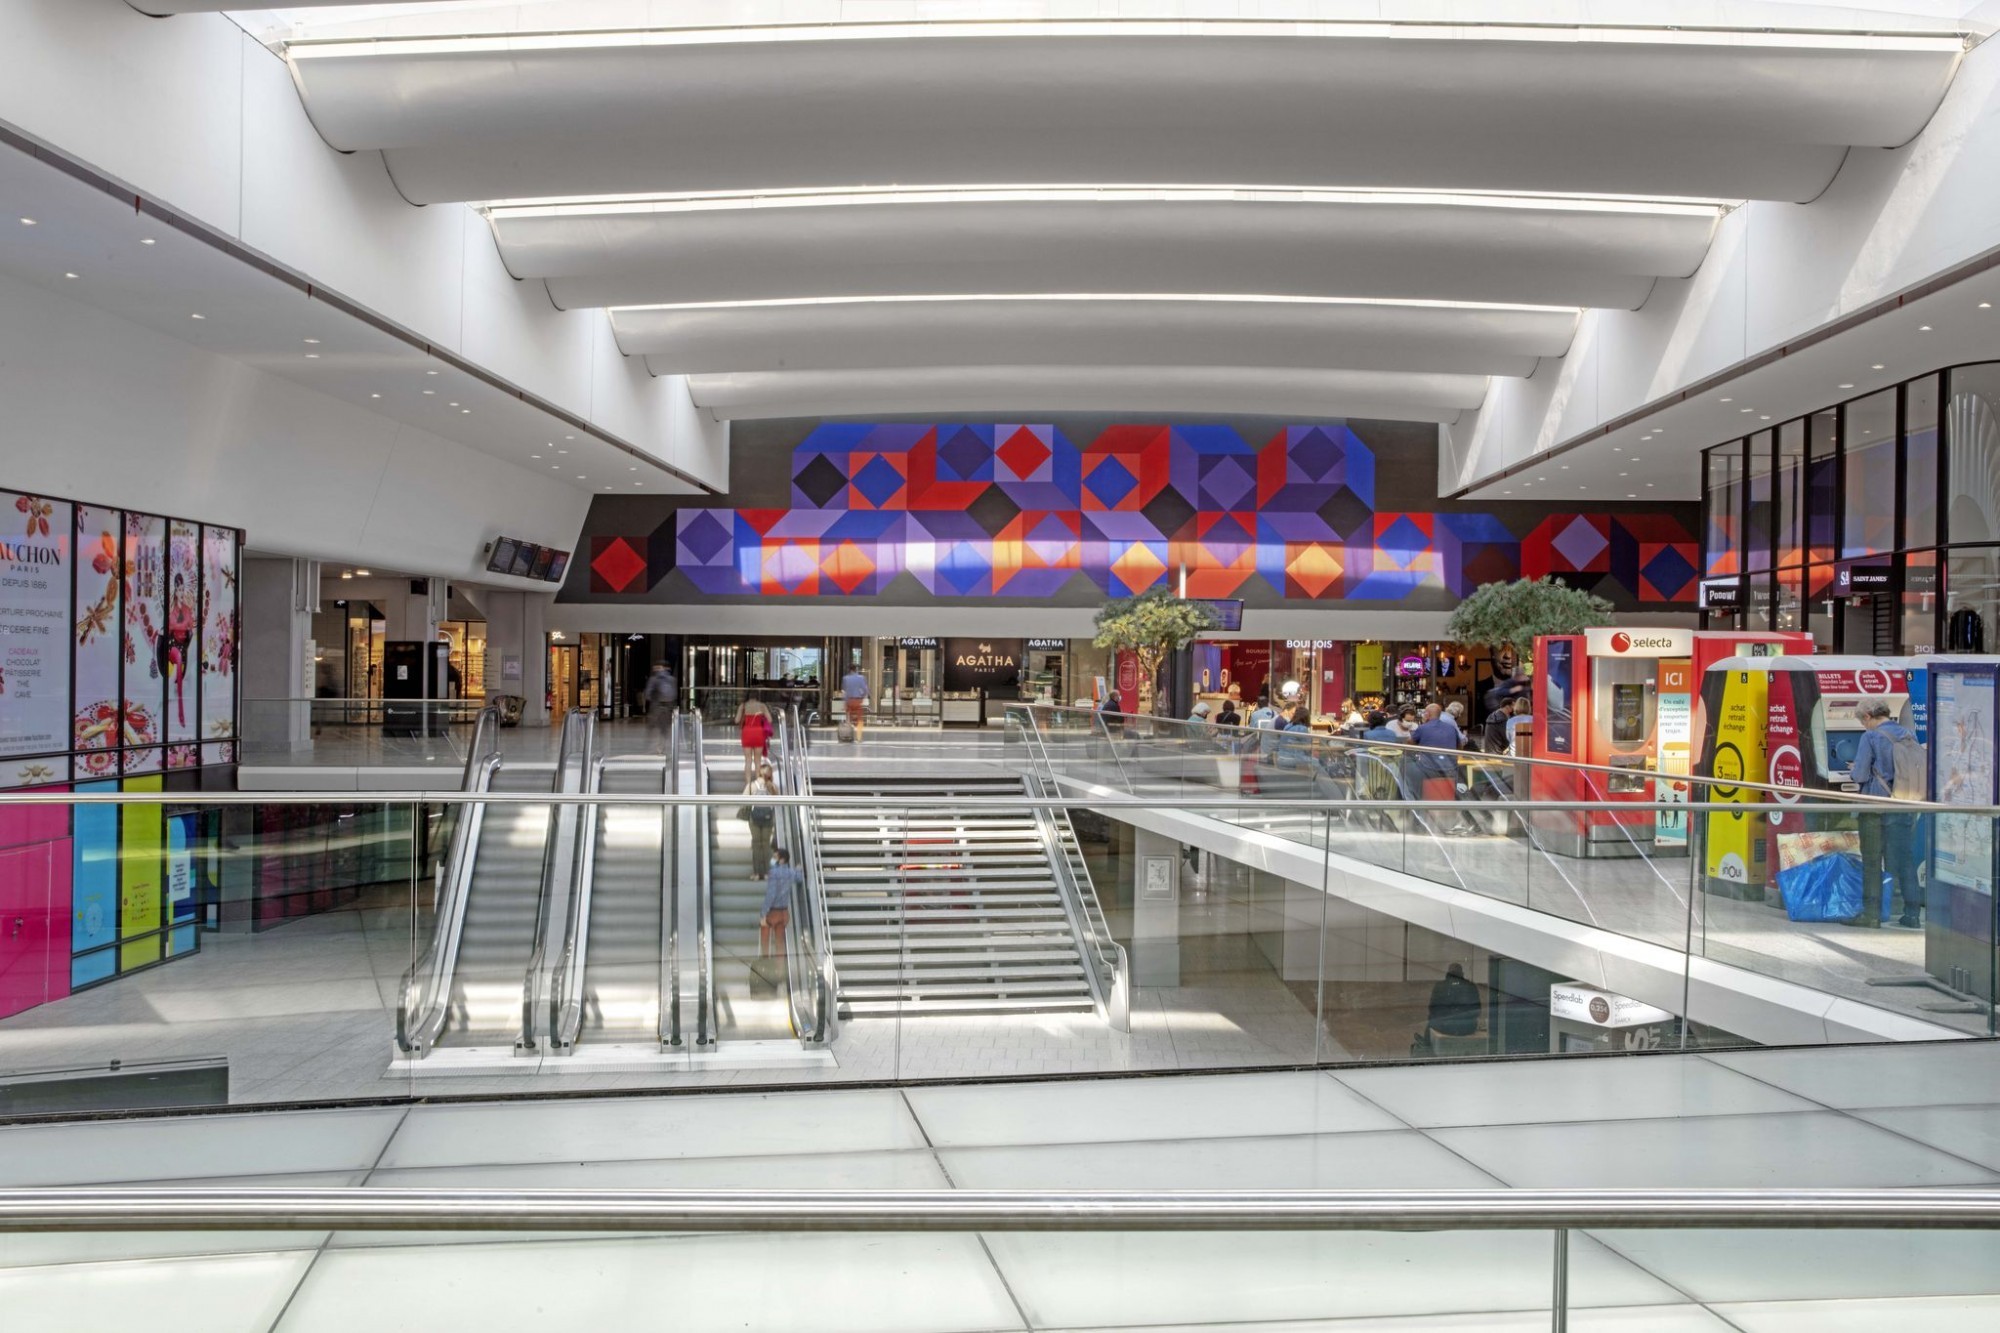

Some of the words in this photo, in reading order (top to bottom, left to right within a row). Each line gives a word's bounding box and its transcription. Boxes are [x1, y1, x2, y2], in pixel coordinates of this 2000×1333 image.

[10, 565, 39, 573] PARIS
[2, 578, 29, 588] DEPUIS
[31, 581, 48, 589] 1886
[26, 609, 63, 618] PROCHAINE
[33, 626, 49, 634] FINE
[901, 638, 936, 646] AGATHA
[1028, 639, 1064, 647] AGATHA
[1286, 640, 1333, 649] BOUJOIS
[1633, 637, 1672, 648] selecta
[956, 655, 1014, 666] AGATHA
[1665, 672, 1682, 686] ICI
[1770, 704, 1785, 712] achat
[1728, 713, 1745, 721] retrait
[1770, 714, 1788, 723] retrait
[1724, 722, 1745, 732] échange
[1770, 724, 1793, 735] échange
[1718, 766, 1723, 779] 3
[1724, 772, 1737, 780] min
[1777, 771, 1783, 785] 3
[1785, 776, 1799, 787] min
[1553, 990, 1584, 1004] Speedlab
